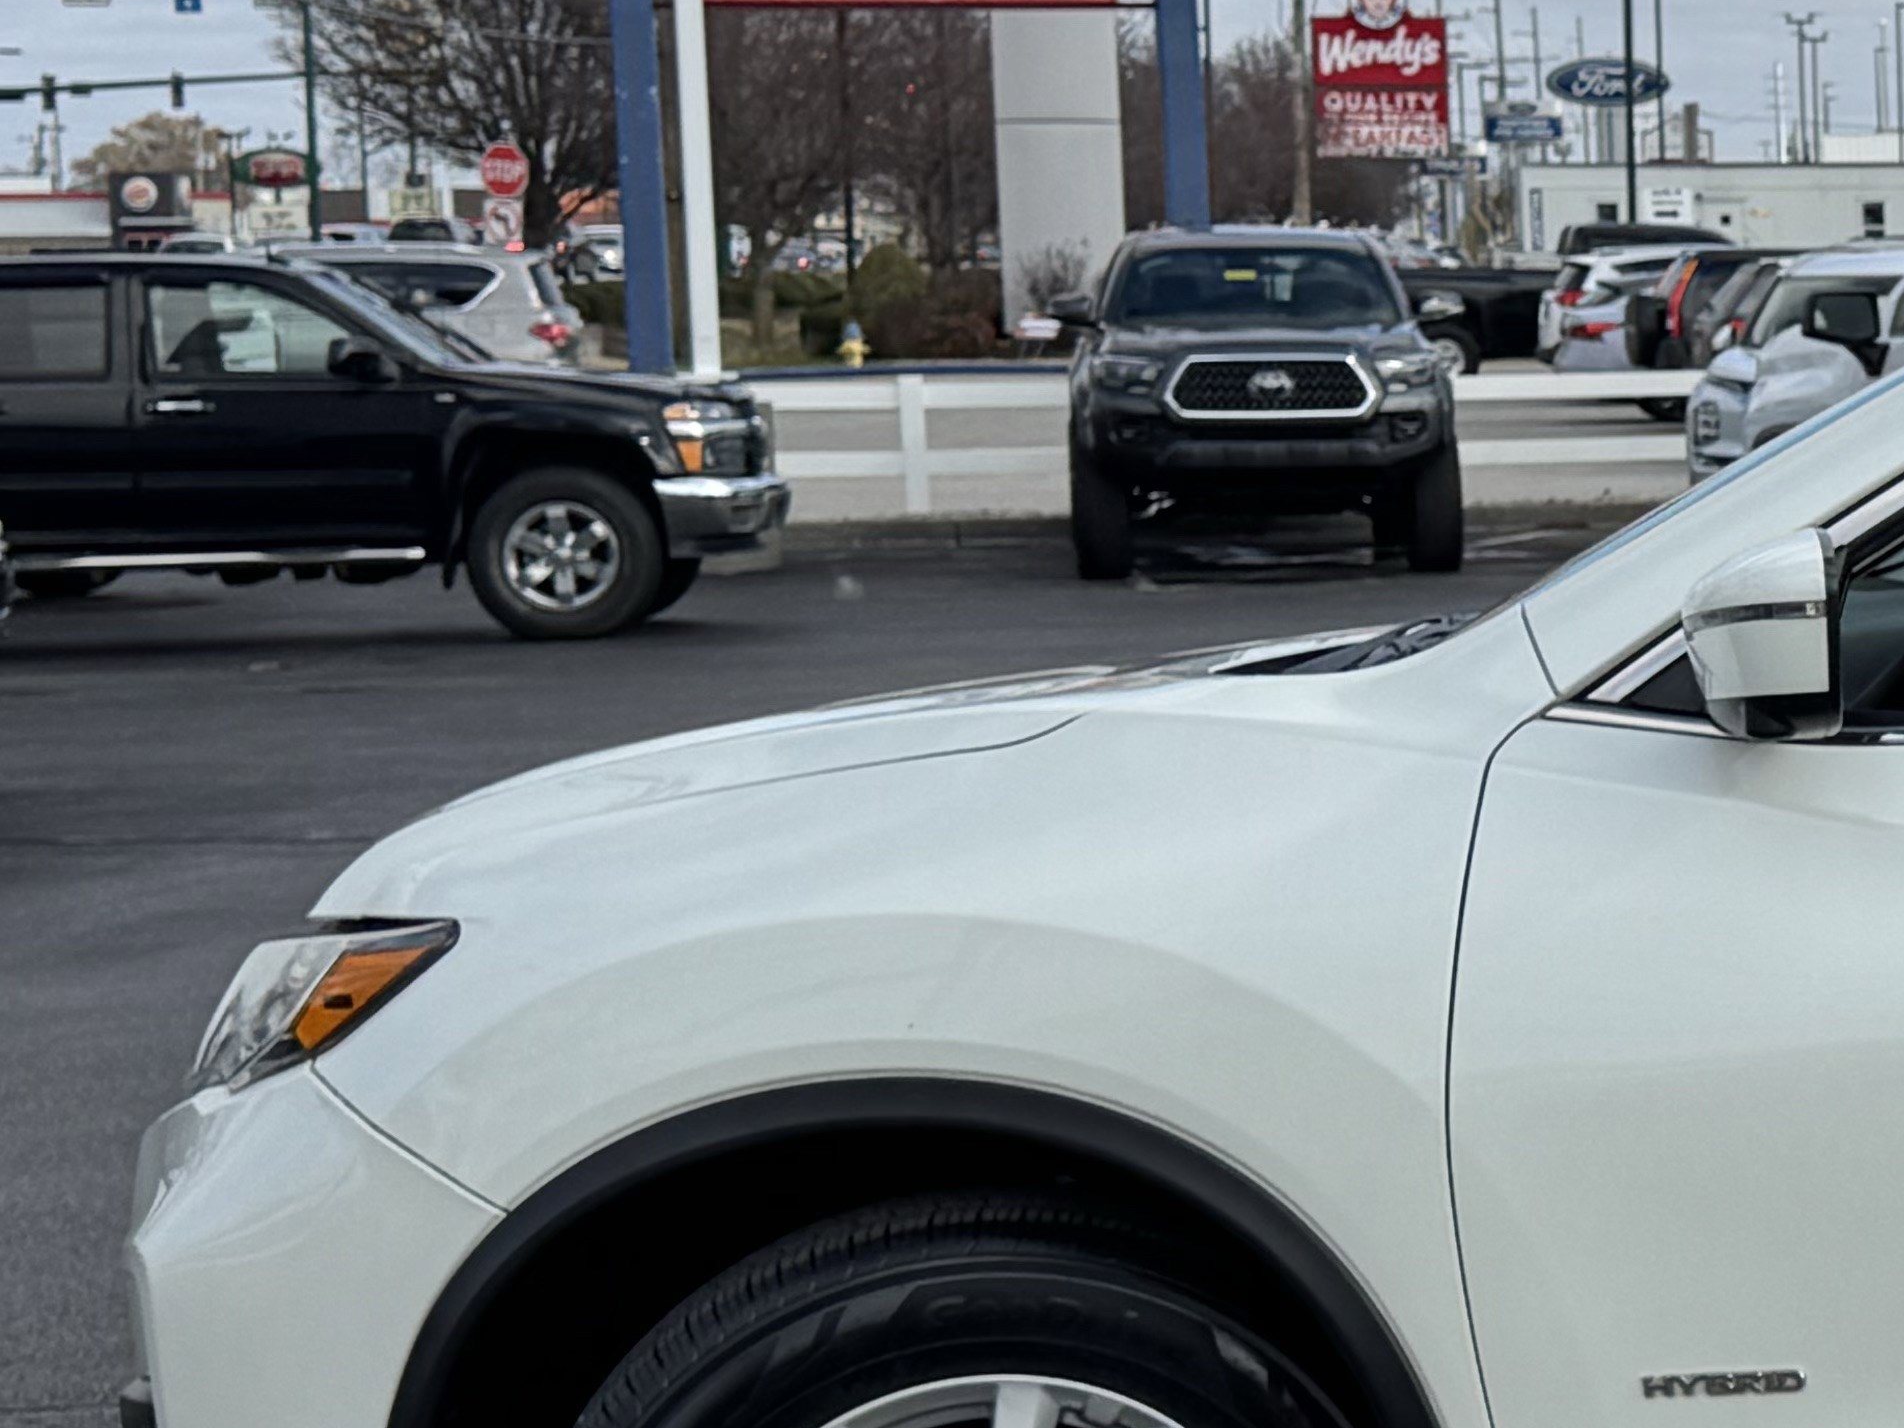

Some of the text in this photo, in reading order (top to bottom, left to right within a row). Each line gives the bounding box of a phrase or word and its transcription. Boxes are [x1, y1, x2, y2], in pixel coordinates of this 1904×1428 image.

[1318, 24, 1442, 76] Wendy's
[1323, 90, 1438, 113] QUALITY
[1641, 1370, 1806, 1399] HYBRID
